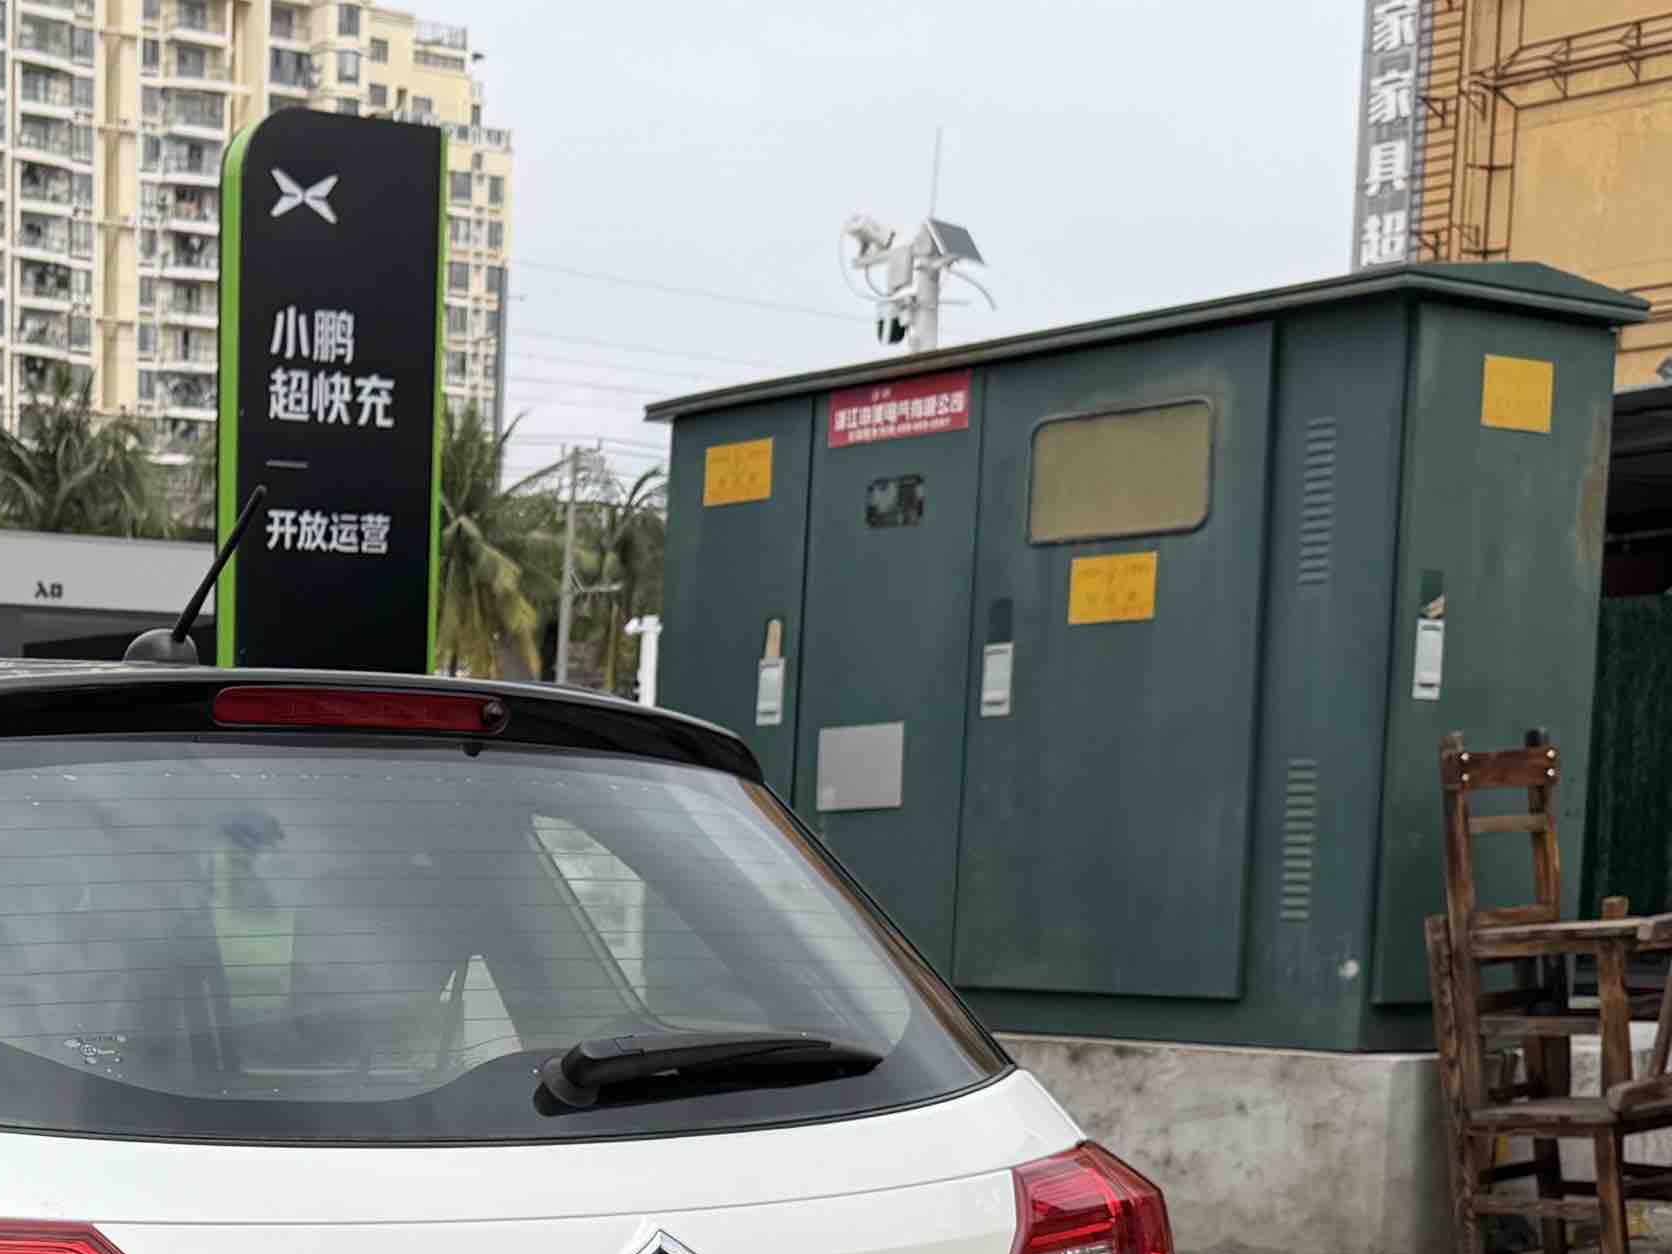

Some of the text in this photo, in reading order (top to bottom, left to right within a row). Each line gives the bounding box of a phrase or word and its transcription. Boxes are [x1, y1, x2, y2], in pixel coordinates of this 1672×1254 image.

[270, 305, 355, 364] 小鹏
[269, 367, 395, 428] 超快充
[266, 509, 392, 554] 开放运营
[34, 580, 63, 599] 入口
